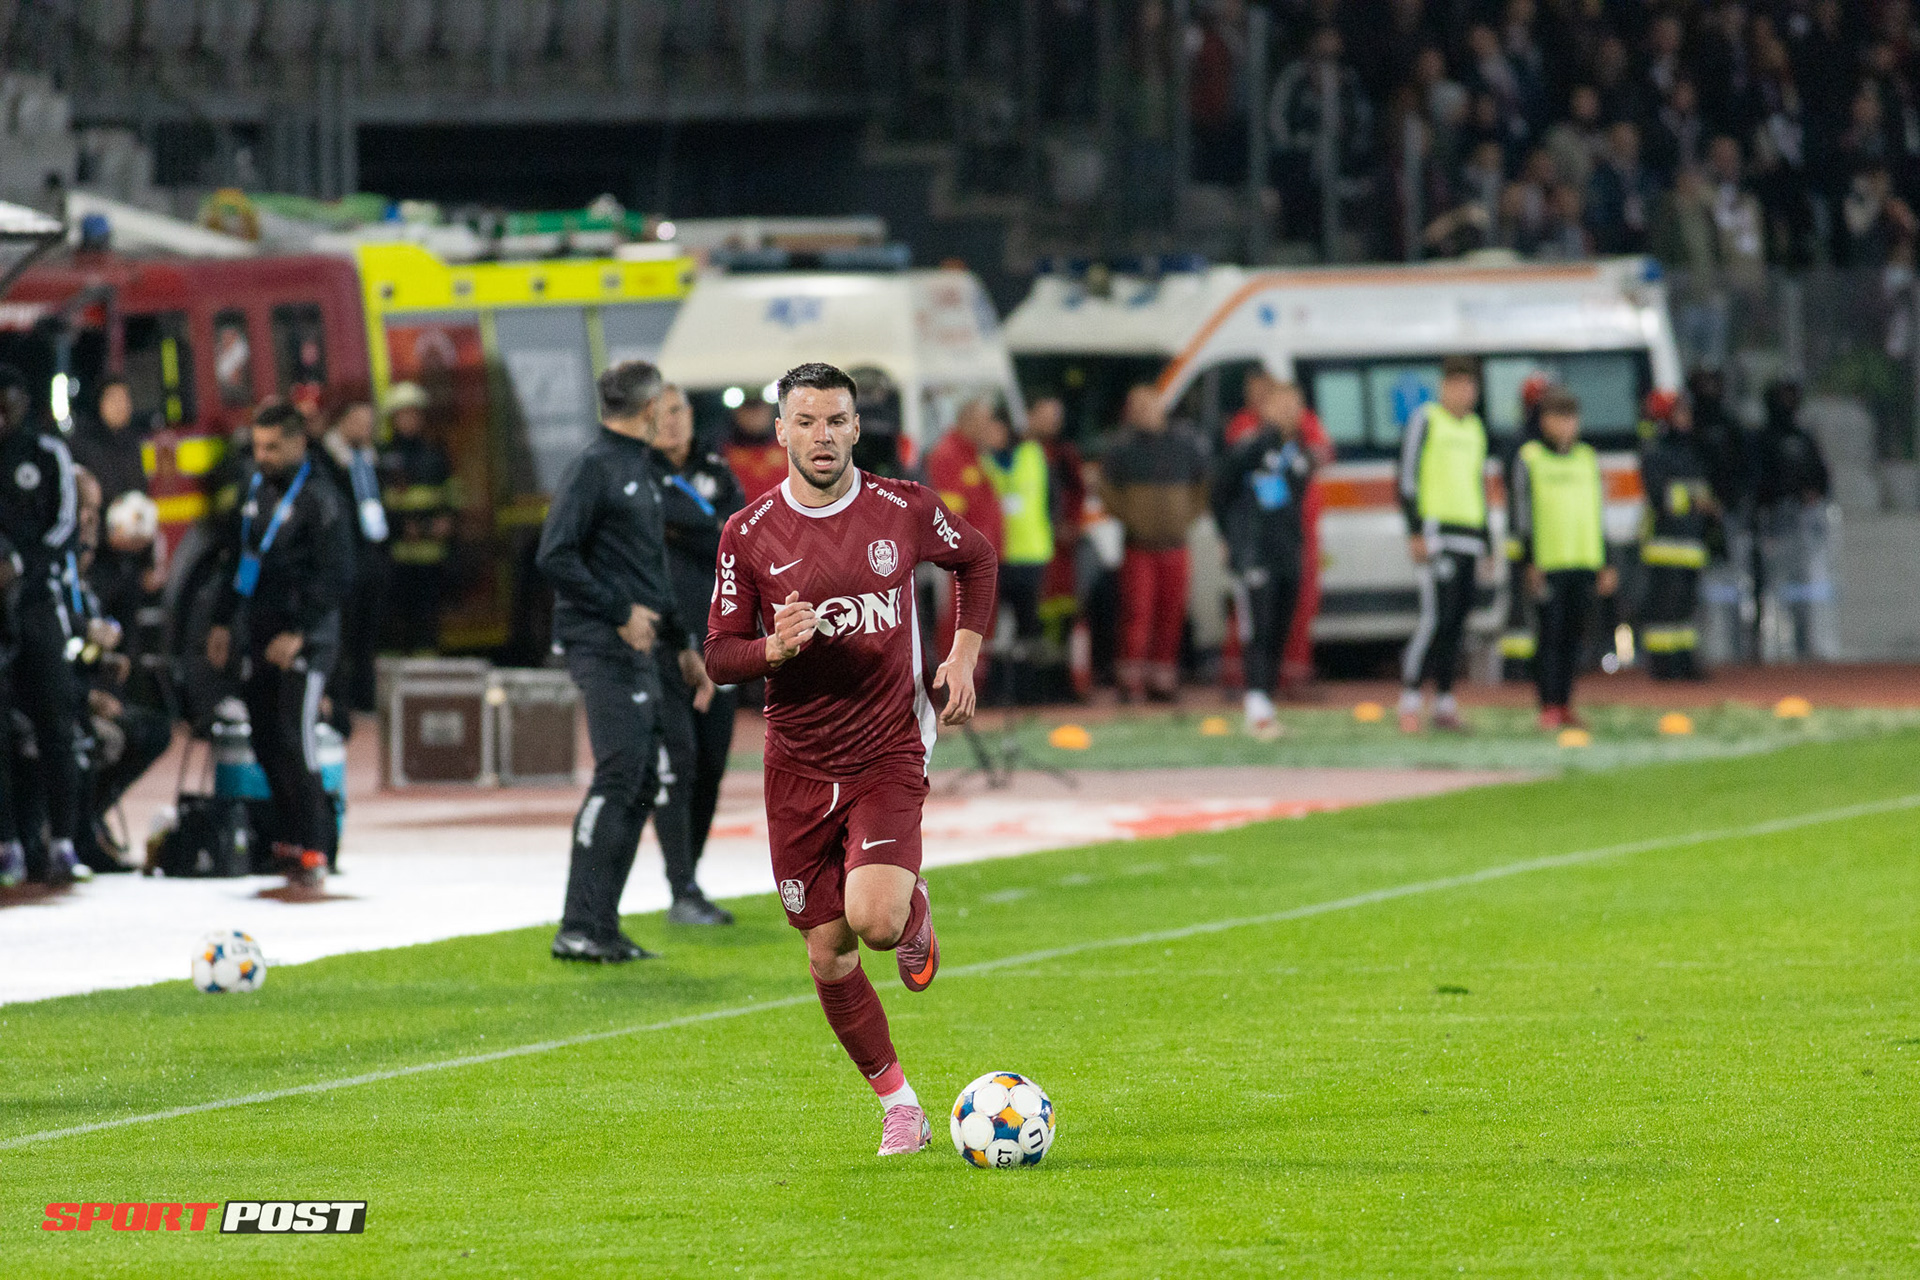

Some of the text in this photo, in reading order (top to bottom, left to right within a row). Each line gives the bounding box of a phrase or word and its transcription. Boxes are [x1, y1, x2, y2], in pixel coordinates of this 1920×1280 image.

[748, 499, 774, 526] avinto
[877, 487, 908, 509] avinto
[936, 518, 962, 549] DSC
[721, 552, 737, 595] DSC
[771, 586, 902, 637] ON
